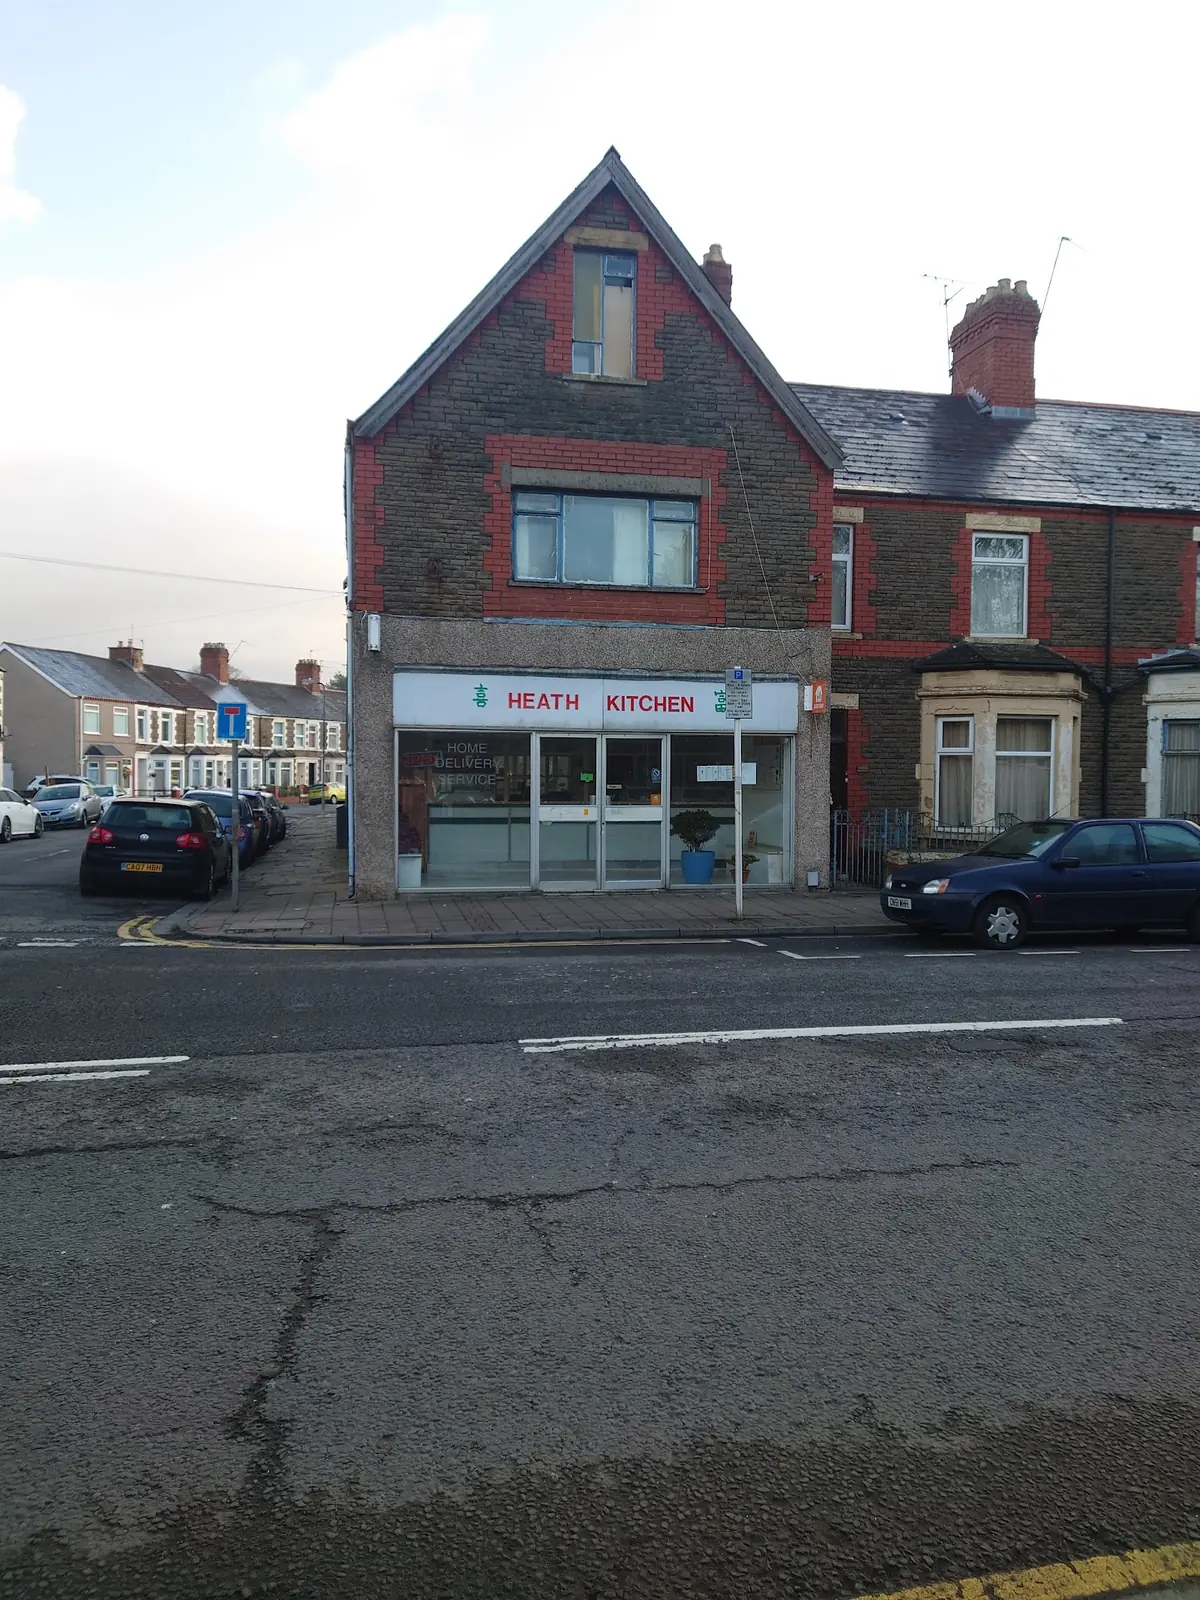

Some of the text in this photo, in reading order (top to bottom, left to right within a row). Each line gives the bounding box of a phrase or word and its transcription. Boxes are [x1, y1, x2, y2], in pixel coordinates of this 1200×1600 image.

[508, 692, 694, 713] HEATH KITCHEN
[447, 742, 488, 754] HOME
[435, 756, 501, 769] DELIVERY
[438, 774, 496, 785] SERVICE
